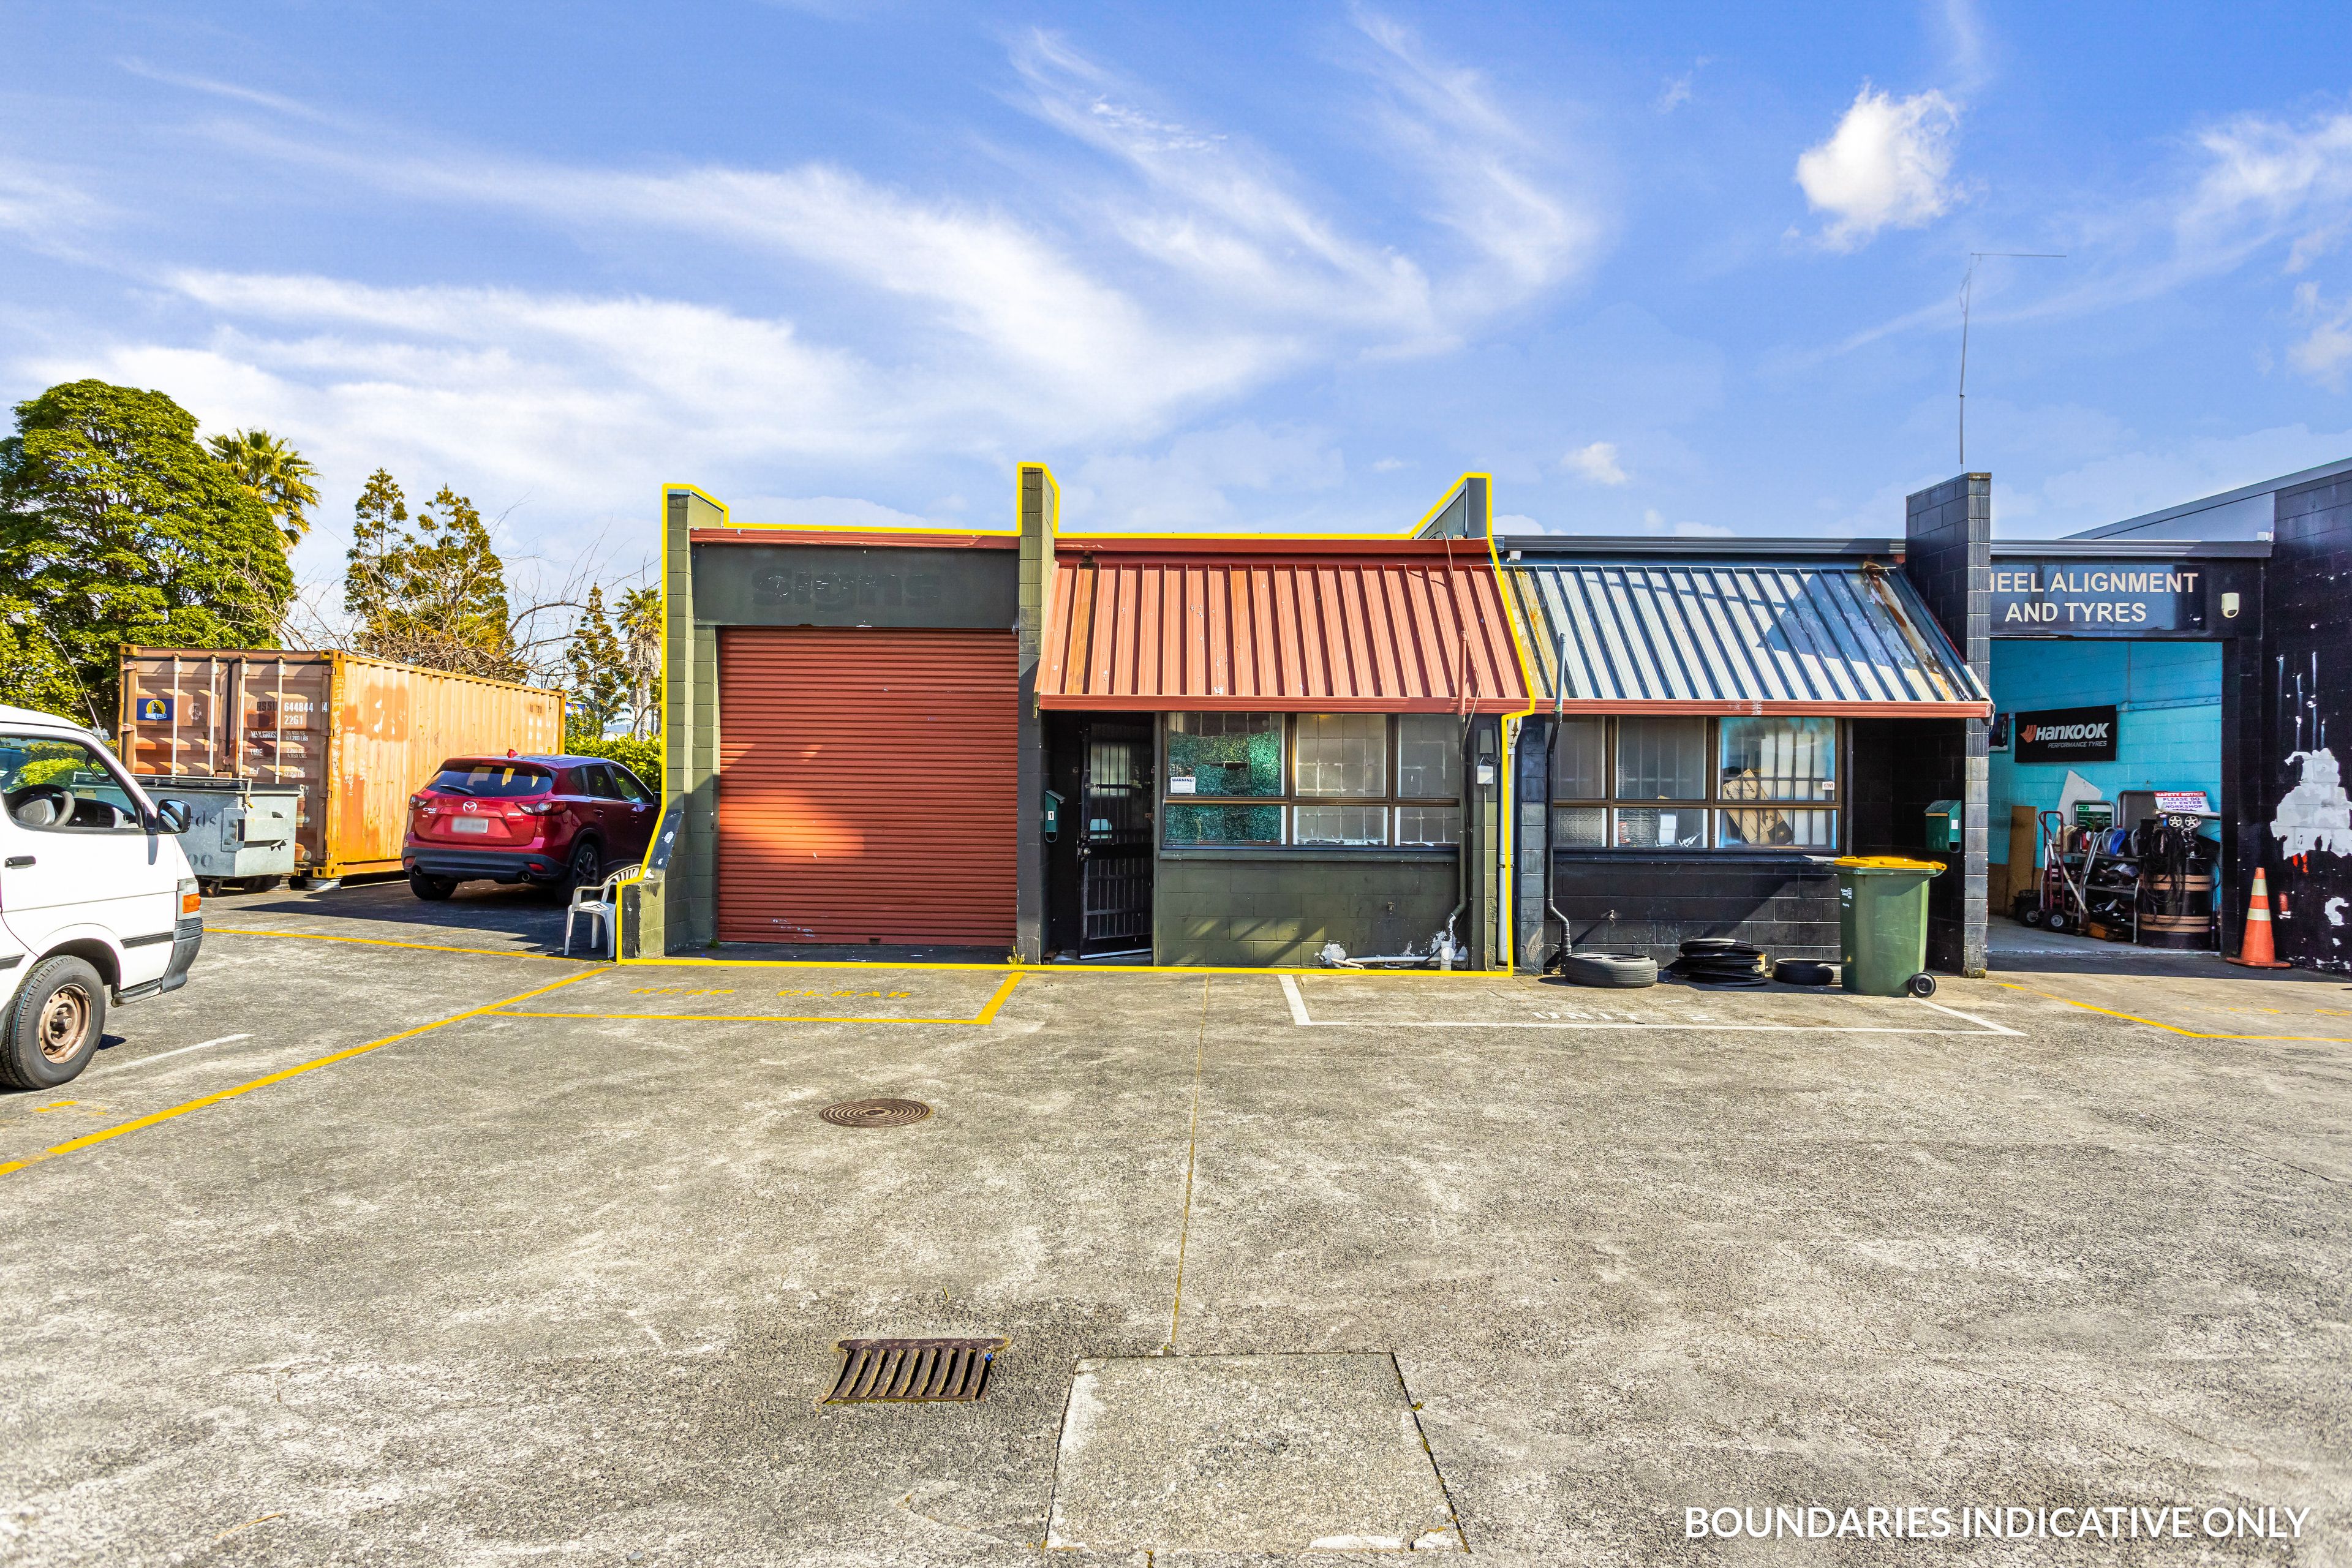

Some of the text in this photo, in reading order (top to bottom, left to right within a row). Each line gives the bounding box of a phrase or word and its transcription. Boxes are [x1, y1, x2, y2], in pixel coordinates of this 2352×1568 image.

[1990, 573, 2198, 592] EEL ALIGNMENT
[2005, 603, 2147, 622] AND TYRES
[284, 702, 314, 712] 644844
[323, 703, 328, 712] 4
[284, 715, 303, 725] 2261
